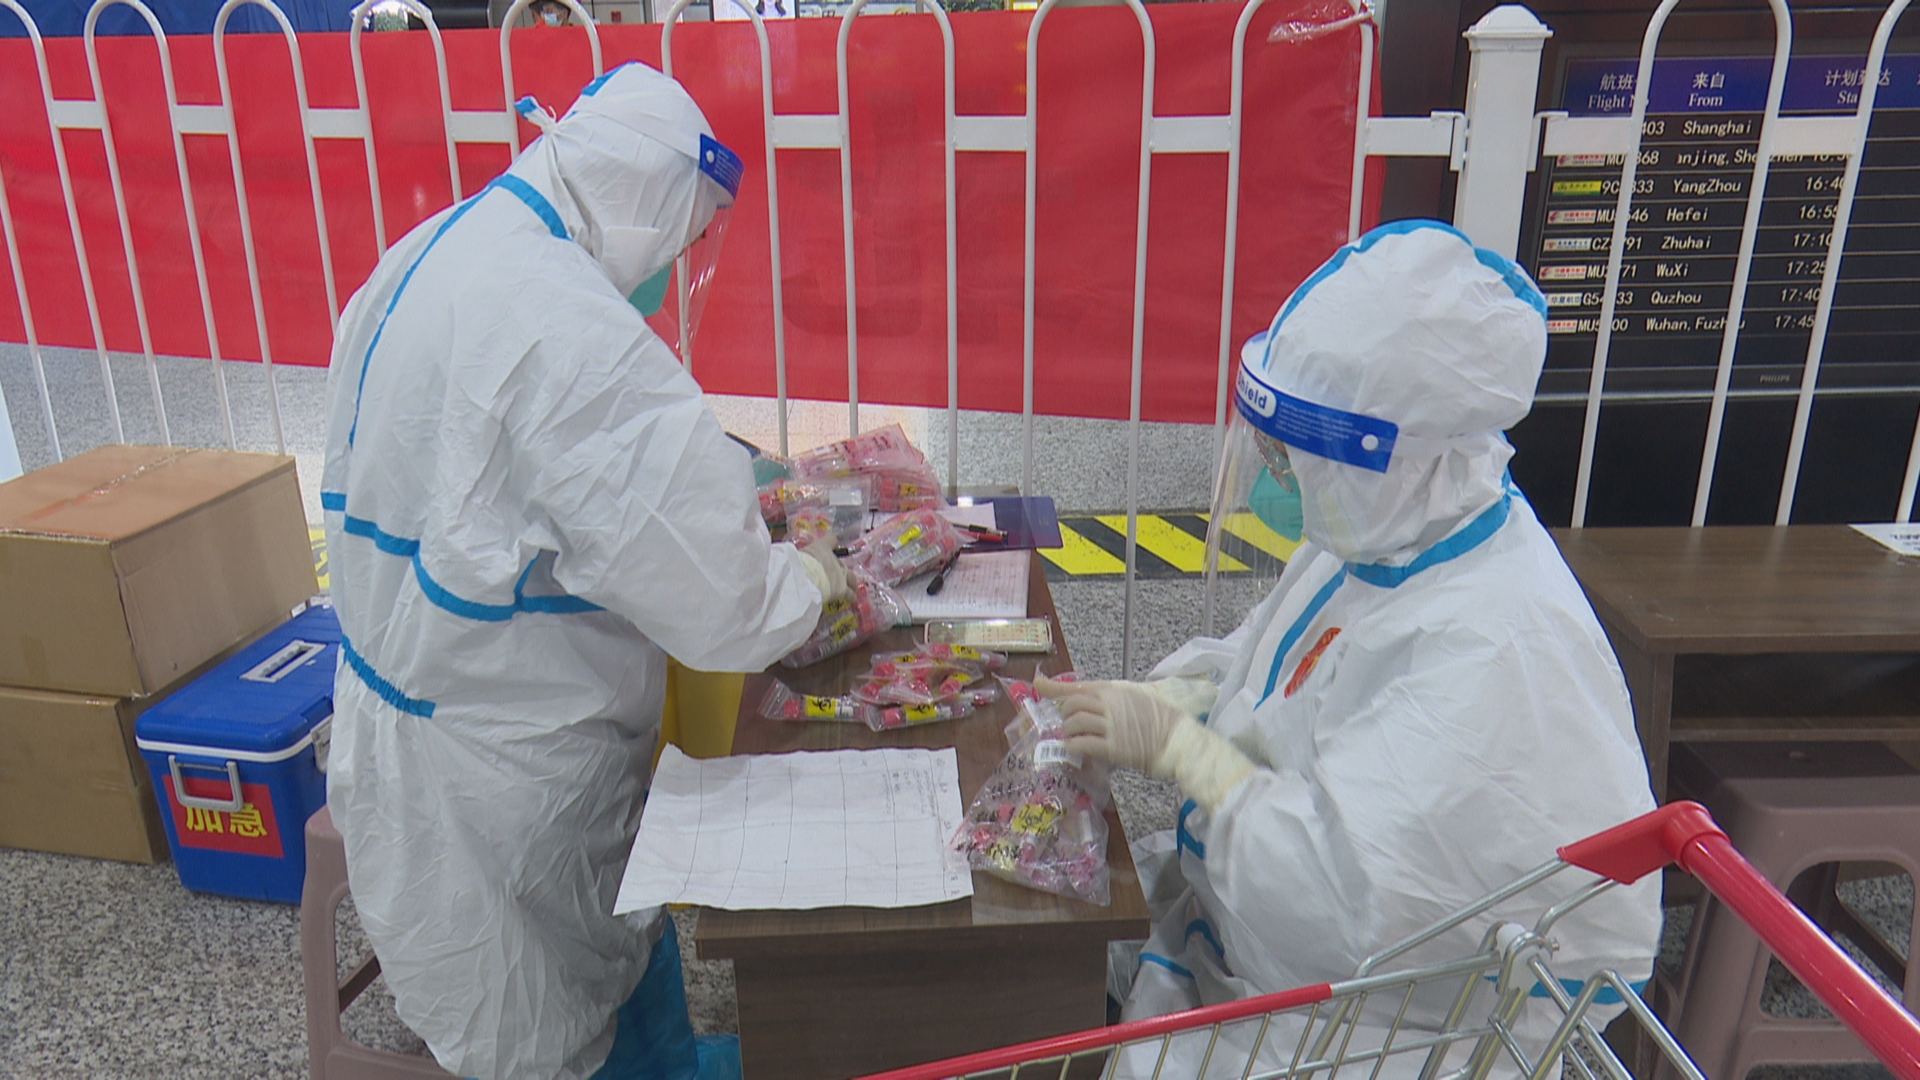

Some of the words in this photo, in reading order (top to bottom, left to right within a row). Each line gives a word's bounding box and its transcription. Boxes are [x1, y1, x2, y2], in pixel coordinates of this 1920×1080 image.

[1600, 72, 1637, 91] 航班
[1693, 71, 1725, 89] 来自
[1588, 94, 1625, 111] Flight
[1689, 92, 1723, 107] From
[1683, 119, 1751, 137] Shanghai
[1673, 178, 1742, 196] YangZhou
[1666, 207, 1709, 222] Hefei
[1661, 235, 1712, 250] Zhuhai
[1656, 263, 1689, 278] WuXi
[1651, 290, 1702, 305] Quzhou
[1781, 288, 1821, 302] 17:40
[1646, 317, 1691, 332] Wuhan,
[1695, 315, 1746, 331] Fuzhu
[1775, 315, 1815, 329] 17:45
[1760, 374, 1790, 383] PHILIPS
[186, 803, 268, 838] 加急
